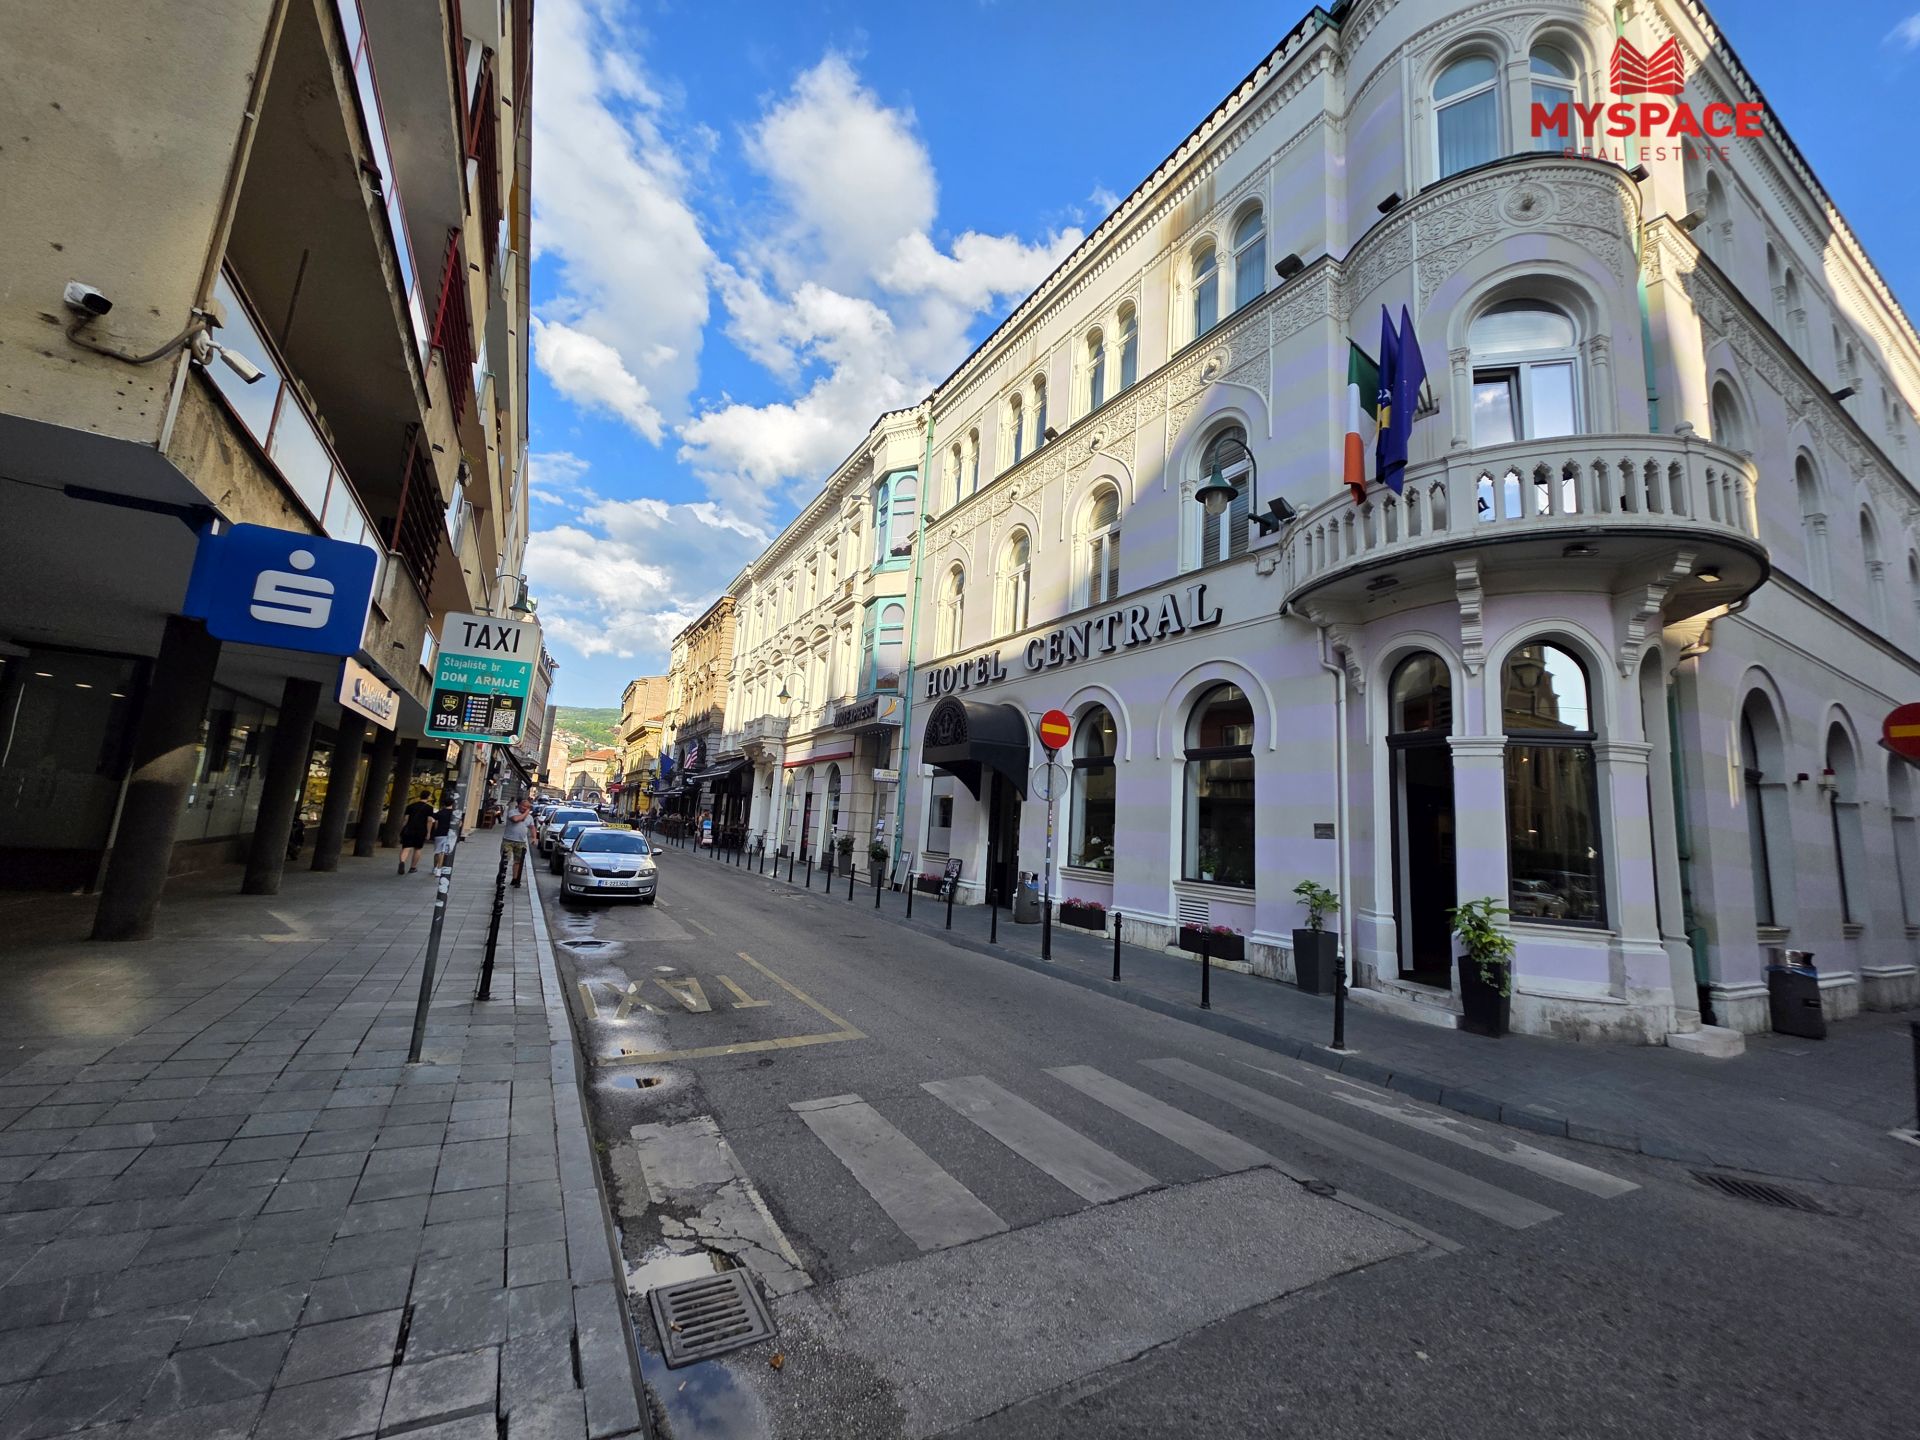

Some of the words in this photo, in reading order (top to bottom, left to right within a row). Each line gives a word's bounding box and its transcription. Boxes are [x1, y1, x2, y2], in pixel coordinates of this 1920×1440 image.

[463, 621, 521, 653] TAXI
[924, 650, 1007, 698] HOTEL
[1023, 583, 1224, 672] CENTRAL
[441, 671, 468, 683] DOM
[474, 676, 521, 689] ARMIJE
[491, 662, 503, 673] br.
[518, 666, 526, 675] 4
[435, 713, 459, 727] 1515
[578, 974, 772, 1021] TAXI
